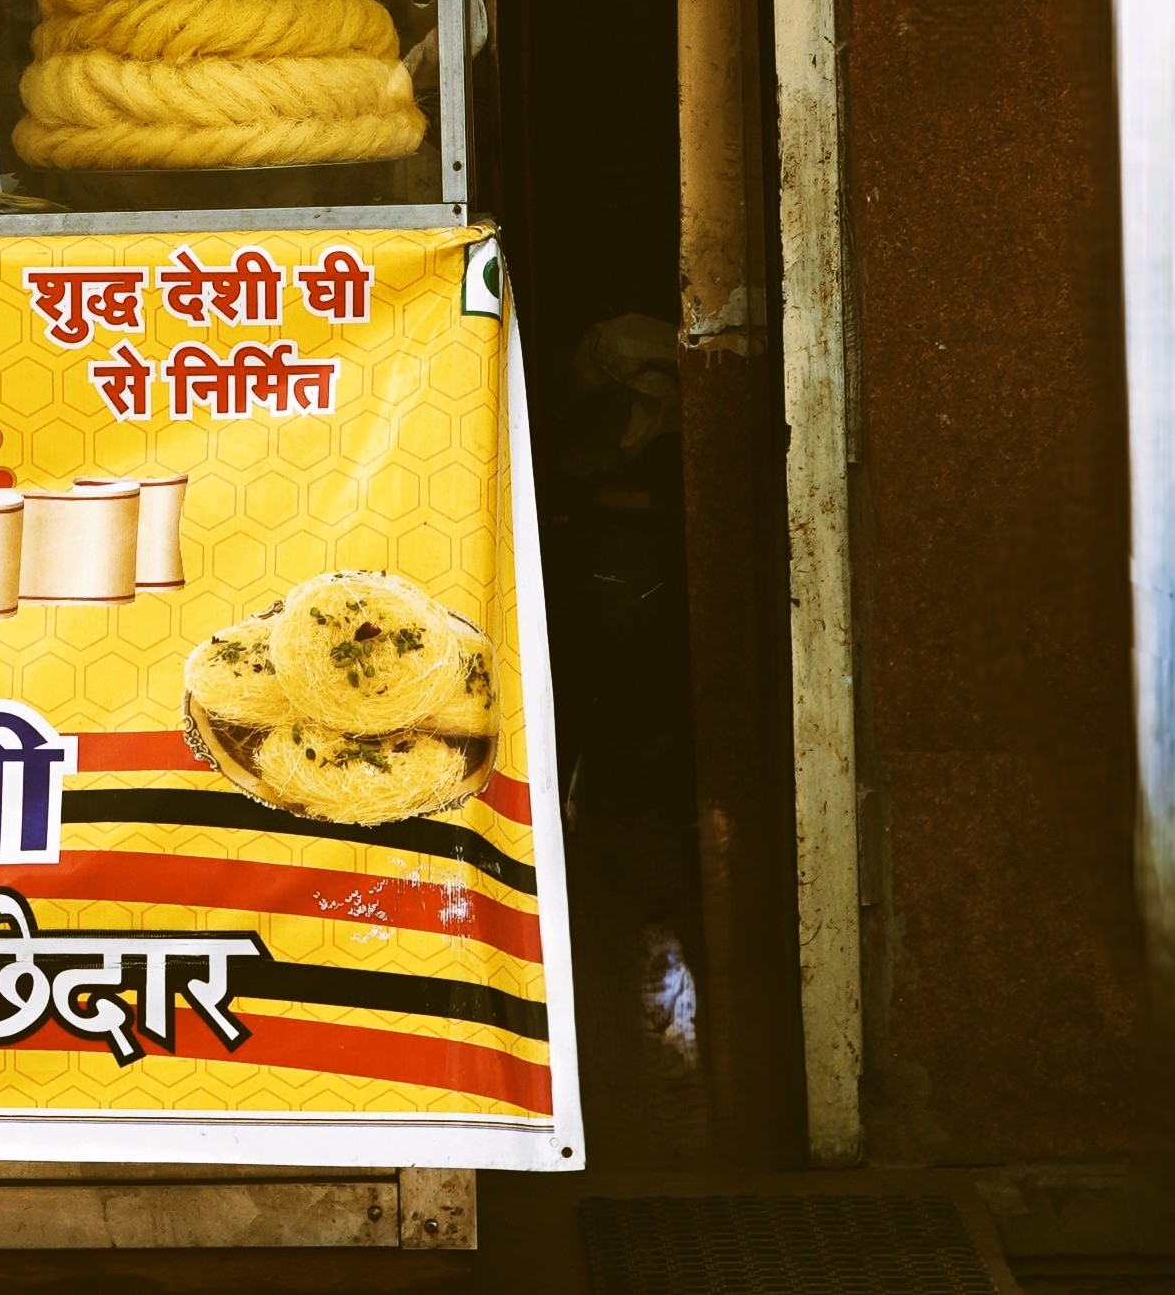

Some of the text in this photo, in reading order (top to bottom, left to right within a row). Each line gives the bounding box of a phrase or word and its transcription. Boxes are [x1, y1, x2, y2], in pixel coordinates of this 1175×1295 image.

[29, 250, 371, 343] शुद्ध देशी घी
[93, 343, 334, 416] से निर्मित
